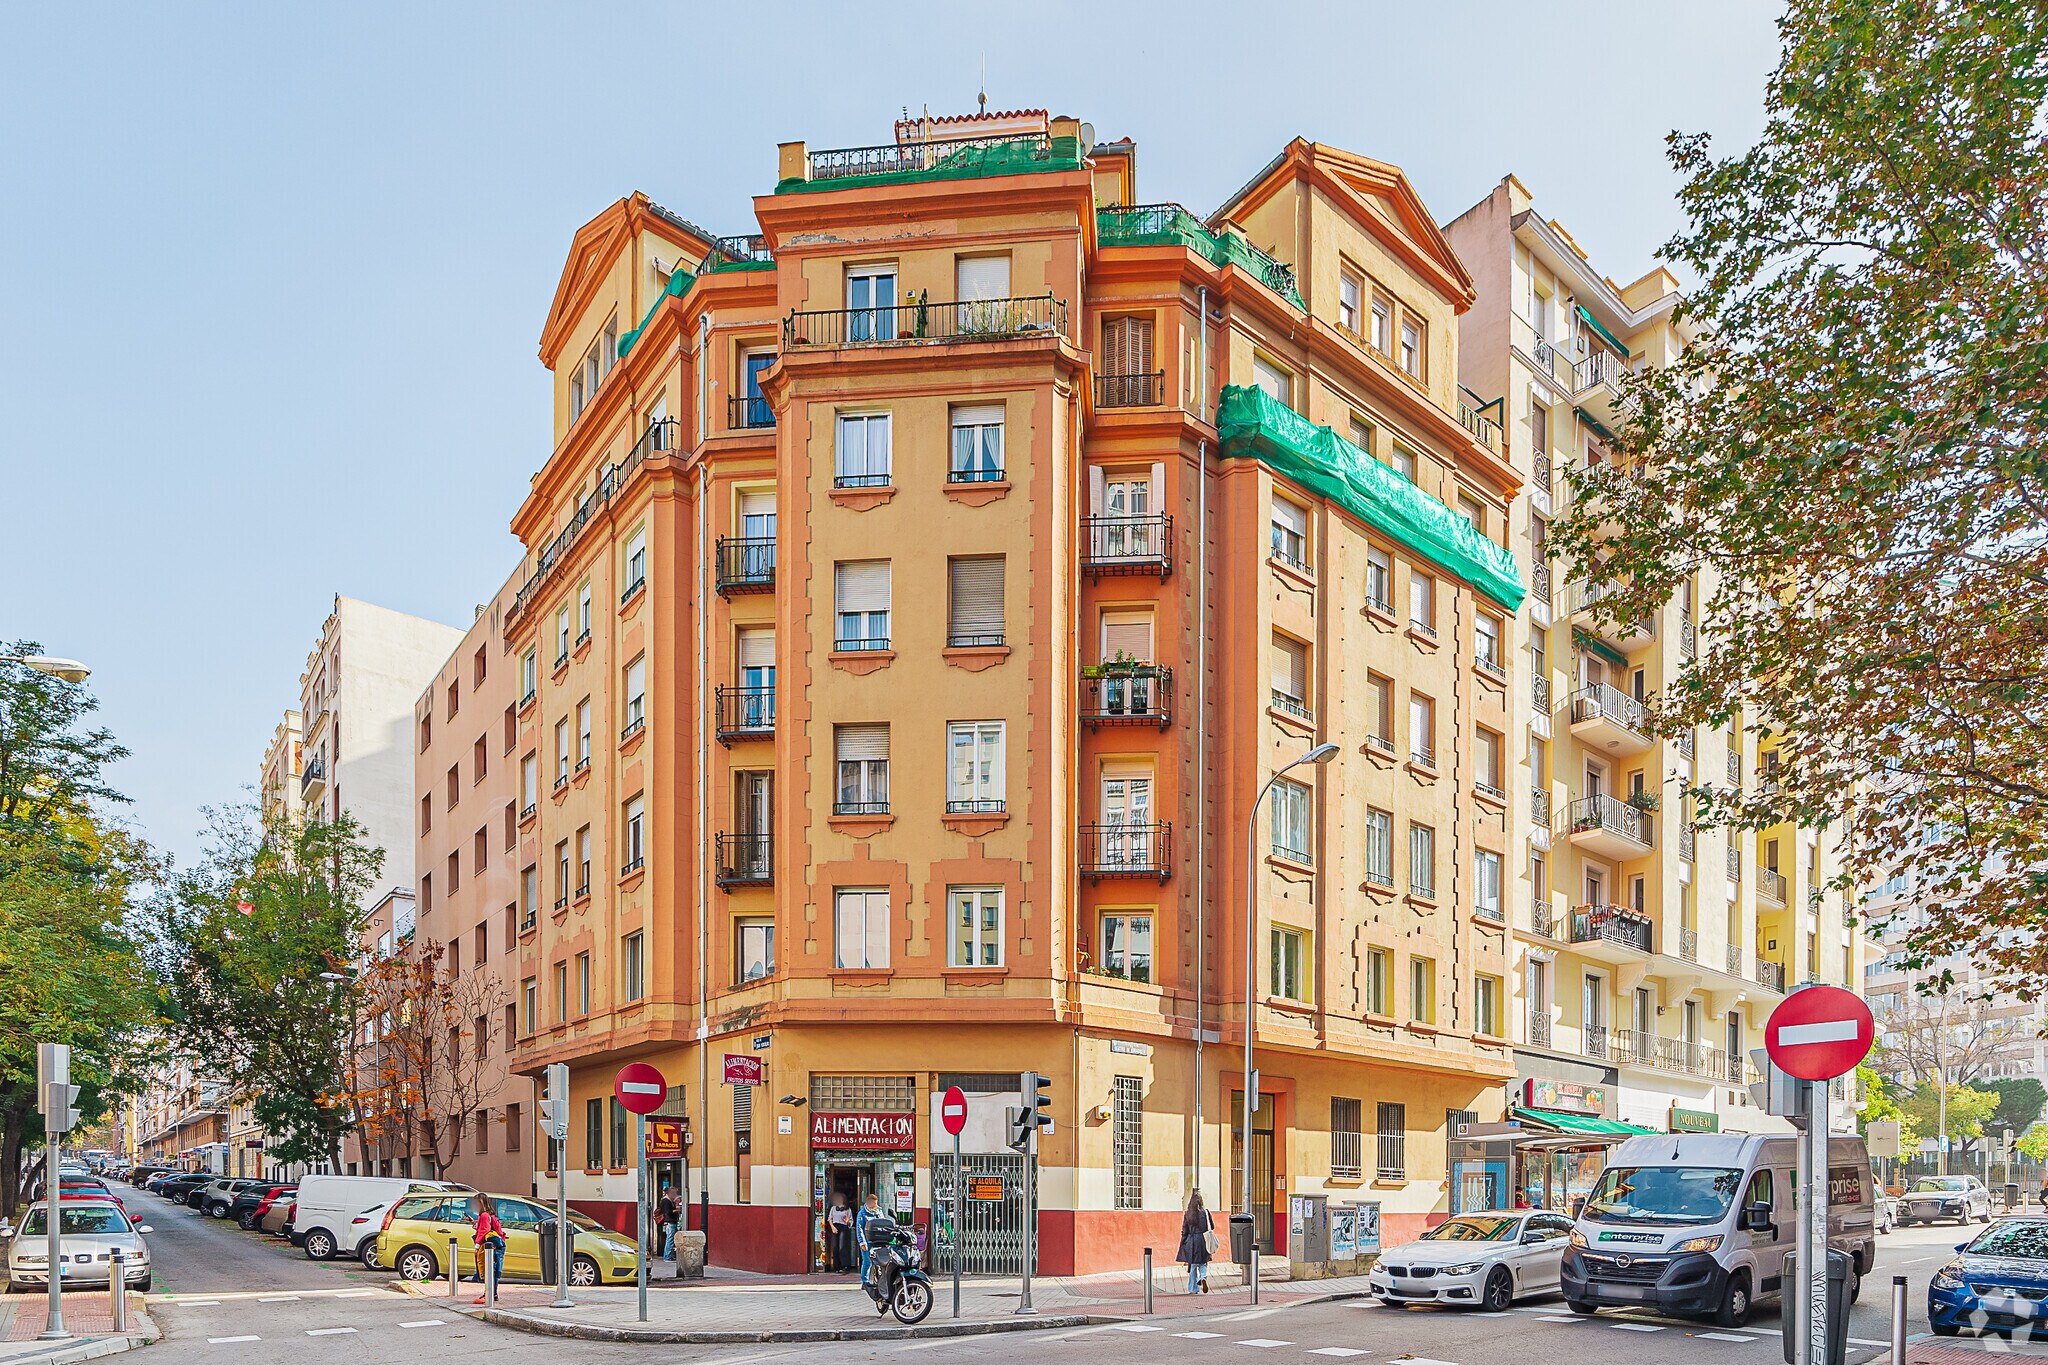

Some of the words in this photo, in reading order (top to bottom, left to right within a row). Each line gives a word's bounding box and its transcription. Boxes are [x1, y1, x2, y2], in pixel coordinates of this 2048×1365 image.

[725, 1057, 760, 1071] ALIMENTACION
[814, 1117, 913, 1135] ALIMENTACION
[1680, 1114, 1713, 1128] NOUVEAU
[969, 1177, 977, 1185] SE
[977, 1177, 1002, 1185] ALQUILA
[1601, 1233, 1663, 1242] enterprise
